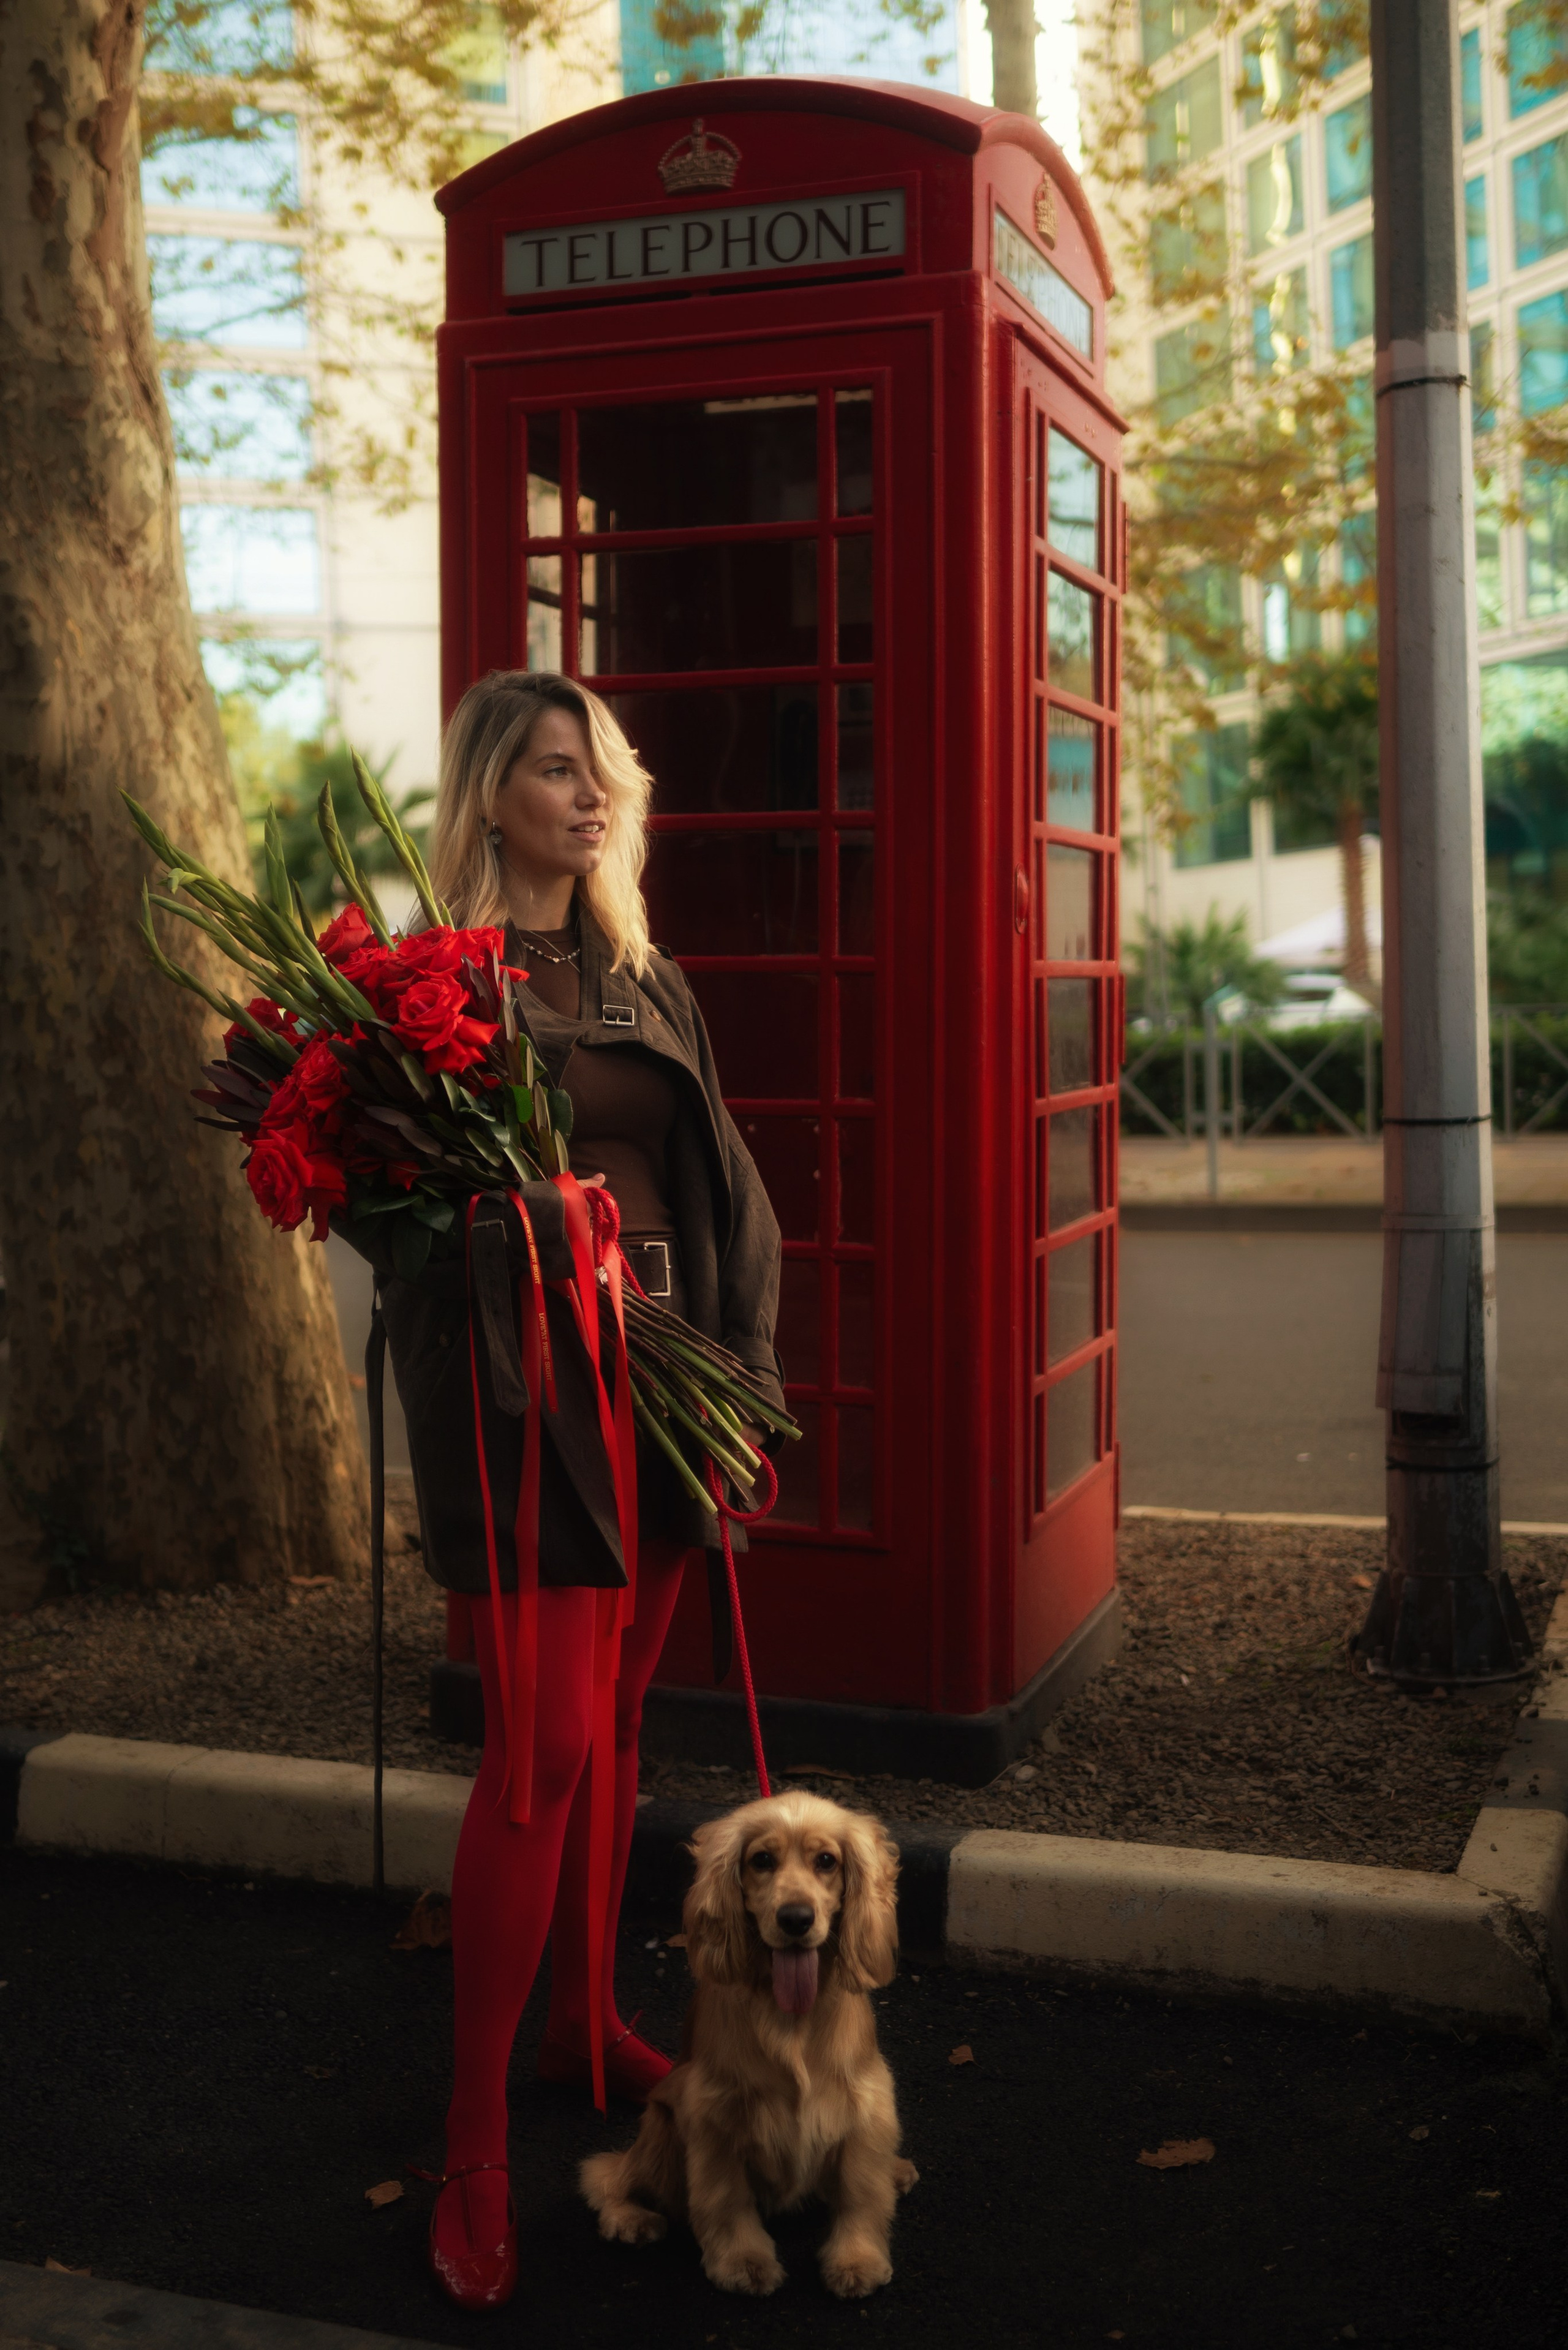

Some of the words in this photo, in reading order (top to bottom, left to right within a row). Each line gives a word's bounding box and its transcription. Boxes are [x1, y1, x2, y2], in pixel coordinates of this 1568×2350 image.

[521, 201, 892, 287] TELEPHONE
[528, 1235, 533, 1243] AT
[541, 1331, 547, 1340] AT
